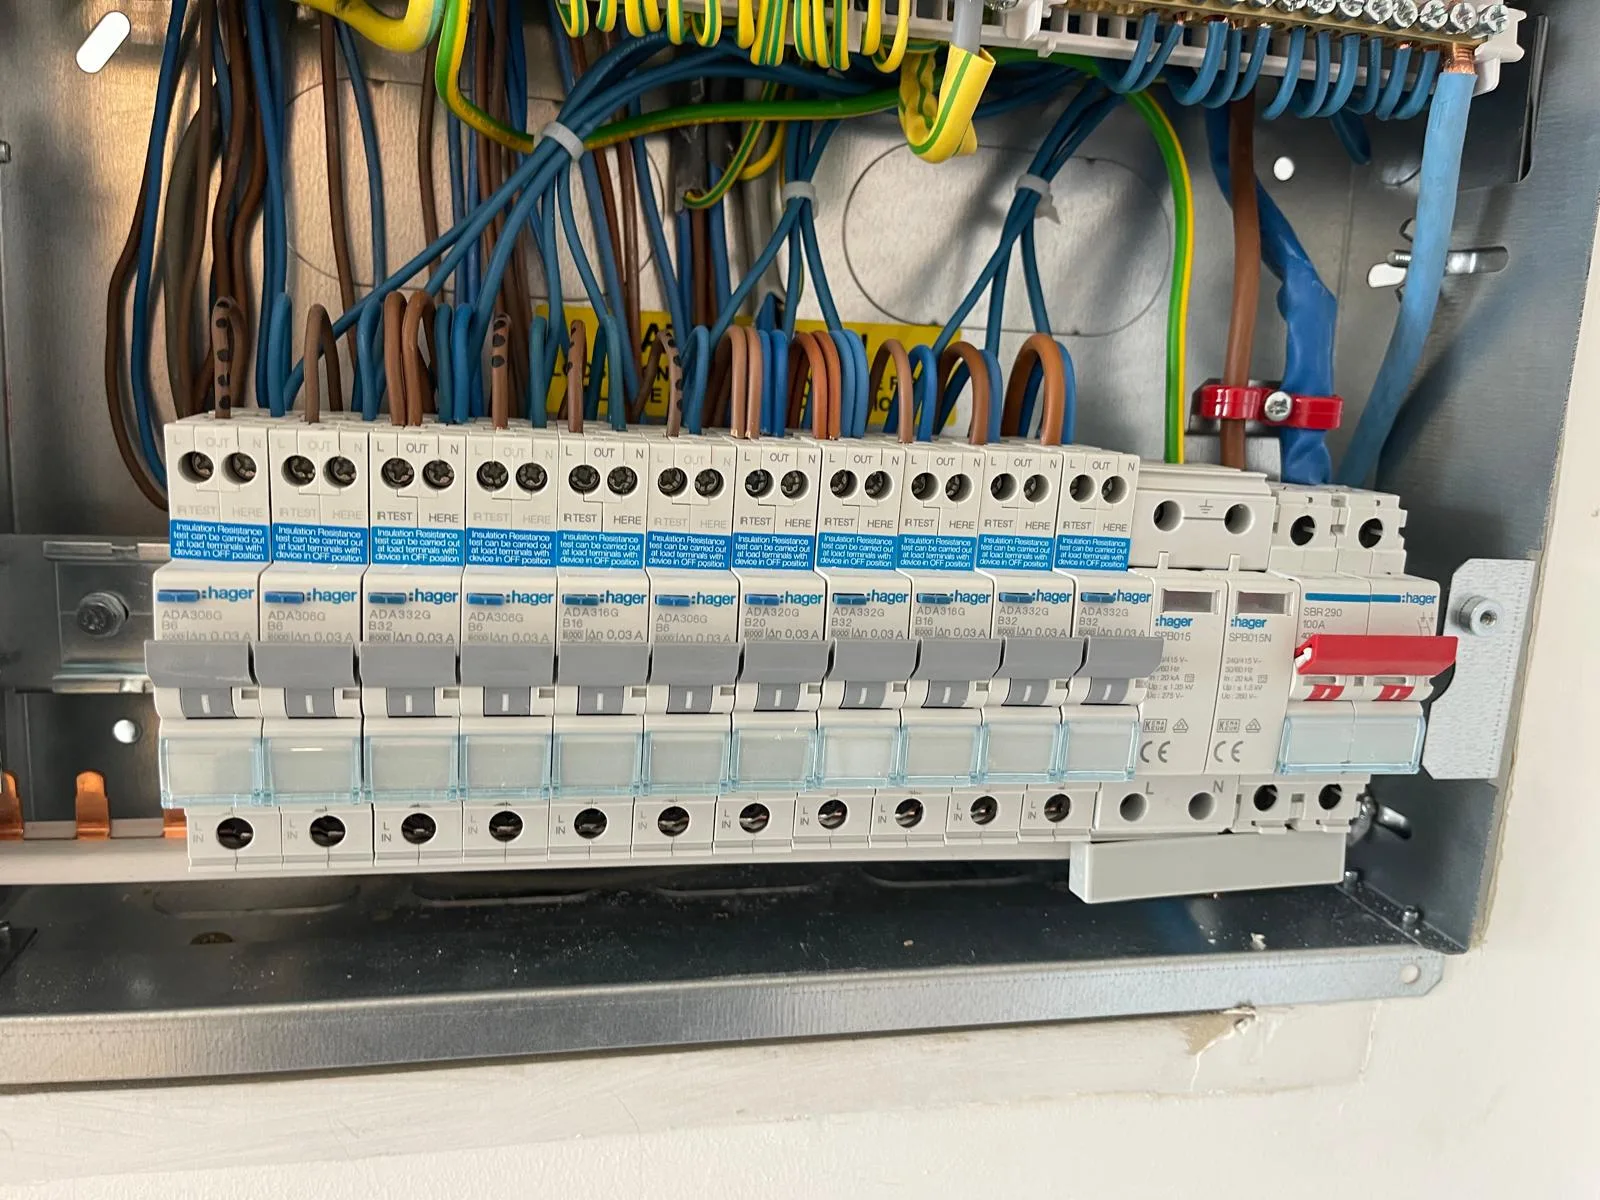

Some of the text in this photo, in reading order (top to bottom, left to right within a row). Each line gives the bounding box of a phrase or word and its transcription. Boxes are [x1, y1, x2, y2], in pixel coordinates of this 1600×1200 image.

[377, 442, 459, 455] L OUT N
[566, 447, 644, 459] L OUT N
[744, 452, 816, 464] L OUT N
[830, 454, 899, 465] L OUT N
[911, 455, 981, 468] L OUT N
[991, 458, 1058, 469] L OUT N
[1070, 460, 1135, 471] L OUT N
[389, 512, 413, 521] TEST
[429, 514, 459, 523] HERE
[574, 514, 598, 522] TEST
[614, 516, 642, 525] HERE
[750, 517, 771, 526] TEST
[785, 519, 812, 528] HERE
[835, 519, 855, 527] TEST
[867, 520, 893, 529] HERE
[914, 519, 935, 528] TEST
[949, 520, 975, 530] HERE
[994, 520, 1014, 528] TEST
[1025, 522, 1050, 531] HERE
[1072, 522, 1092, 530] TEST
[1103, 524, 1128, 532] HERE
[177, 523, 262, 536] Insulation Resistance
[378, 528, 458, 539] Insulation Resistance
[174, 531, 189, 539] test
[252, 537, 265, 545] out
[375, 537, 389, 545] test
[408, 538, 418, 546] be
[207, 542, 243, 551] terminals
[246, 544, 262, 552] with
[387, 545, 403, 553] load
[406, 546, 440, 554] terminals
[175, 548, 264, 560] device in OFF position
[376, 553, 400, 561] device
[403, 553, 409, 561] in
[430, 555, 459, 563] position
[369, 610, 431, 620] ADA332G
[564, 608, 619, 618] ADA316G
[746, 608, 799, 617] ADA320G
[833, 608, 885, 617] ADA332G
[917, 607, 965, 616] ADA316G
[1000, 607, 1049, 615] ADA332G
[1080, 608, 1129, 617] ADA332G
[1304, 608, 1342, 617] SBR 290
[563, 619, 583, 628] B16
[745, 618, 766, 627] B20
[832, 618, 852, 627] B32
[916, 617, 934, 625] B16
[998, 617, 1018, 625] B32
[1079, 617, 1098, 626] B32
[162, 621, 178, 631] B6
[268, 622, 283, 631] B6
[369, 621, 393, 631] B32
[468, 623, 483, 632] B6
[656, 623, 670, 632] B6
[634, 631, 644, 640] A
[810, 631, 819, 639] A
[895, 631, 904, 639] A
[1229, 634, 1272, 643] SPB015N
[1146, 782, 1154, 795] L
[1213, 780, 1224, 793] N
[1030, 801, 1037, 810] L
[725, 810, 730, 818] L
[954, 813, 962, 821] IN
[1028, 812, 1037, 821] IN
[558, 815, 564, 823] L
[878, 816, 887, 824] IN
[383, 822, 390, 830] L
[722, 820, 731, 829] IN
[555, 826, 566, 835] IN
[382, 834, 391, 842] IN
